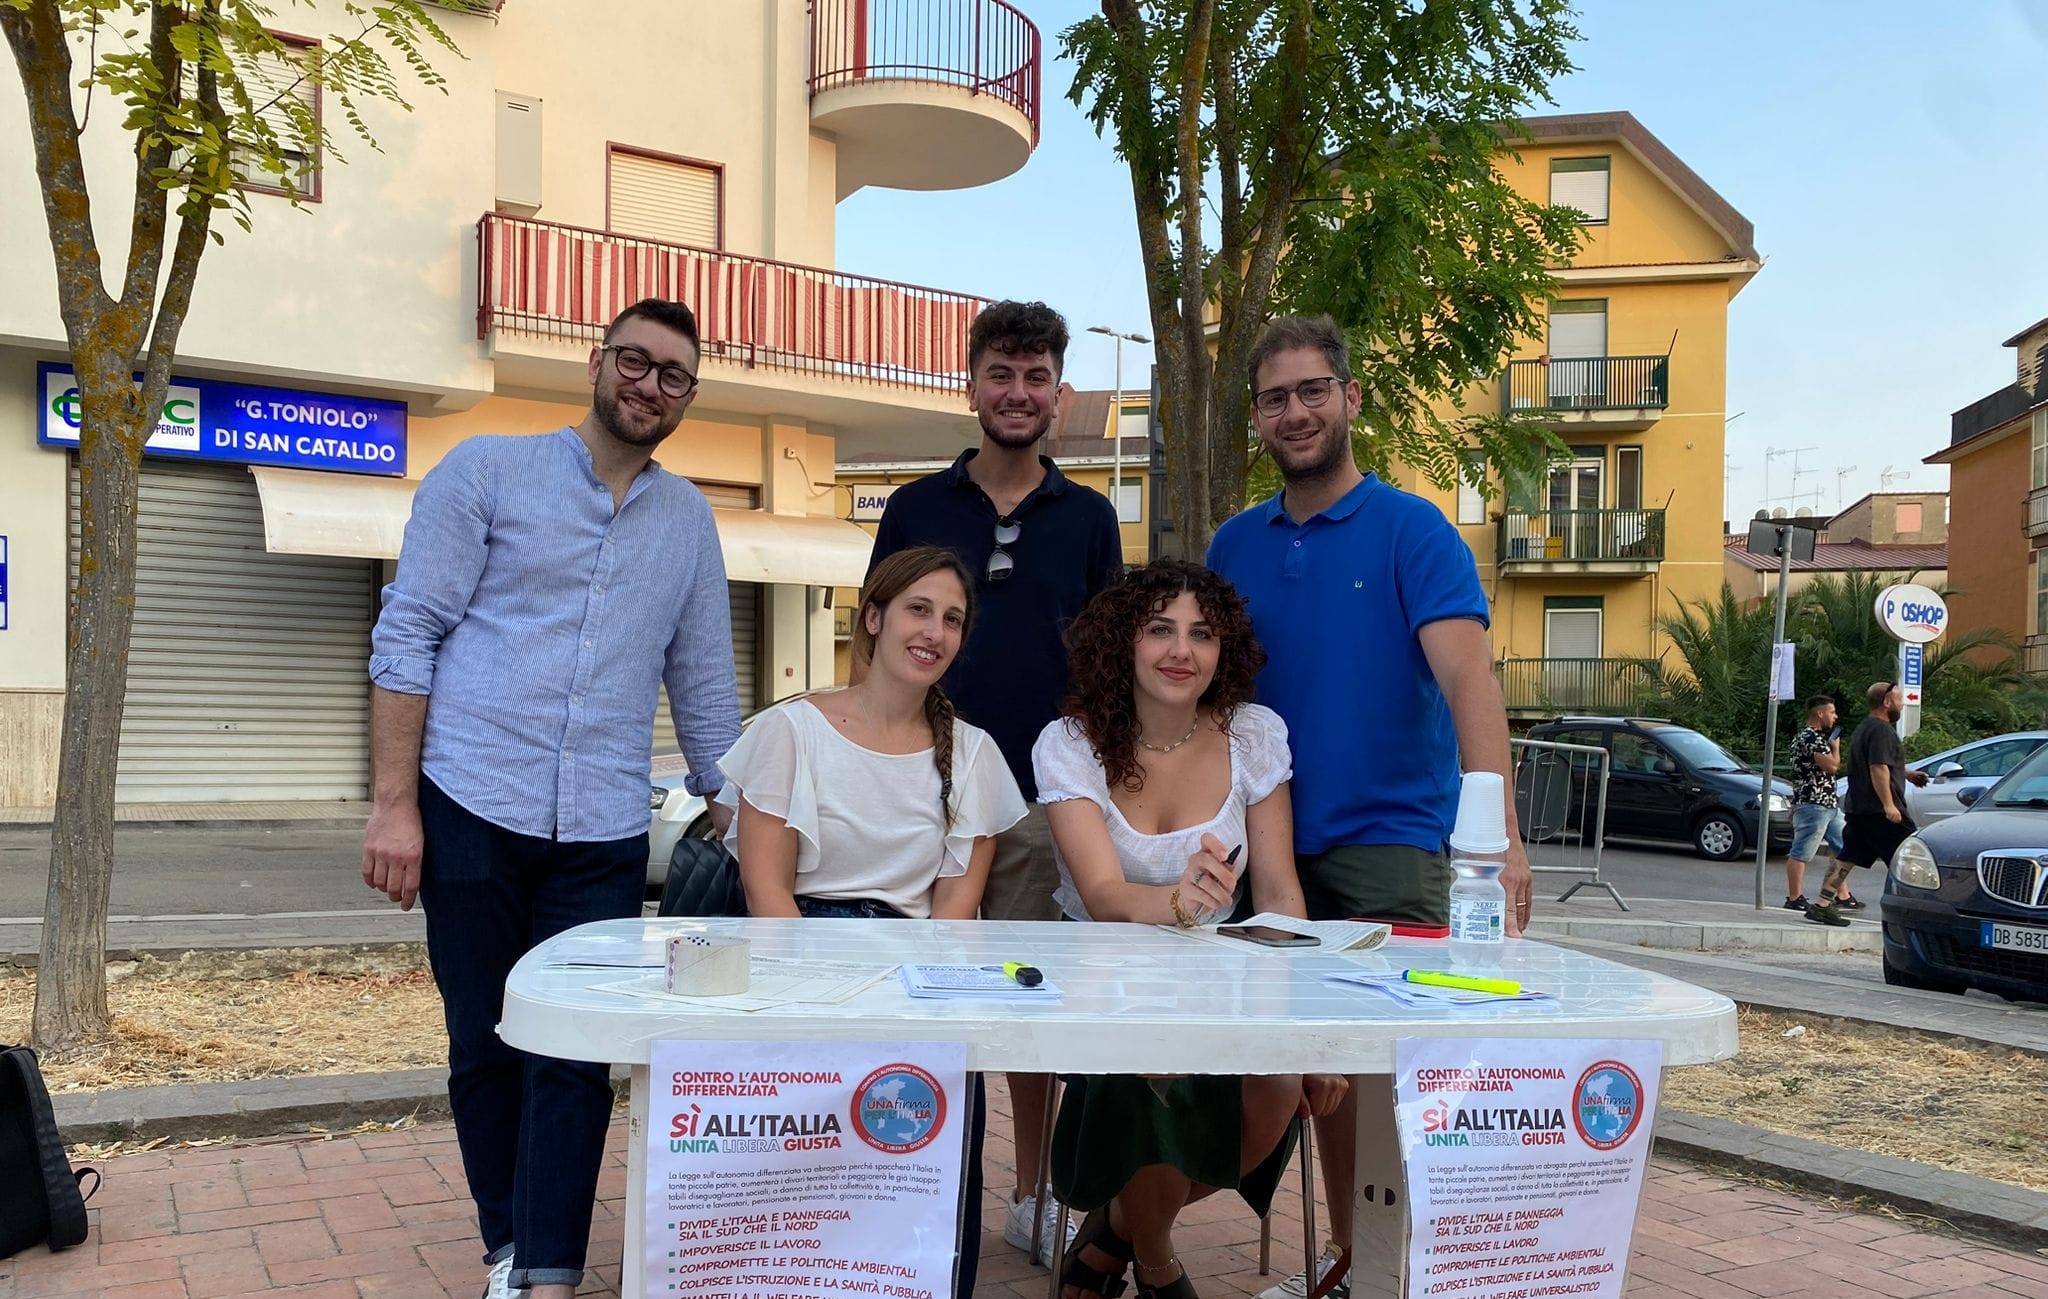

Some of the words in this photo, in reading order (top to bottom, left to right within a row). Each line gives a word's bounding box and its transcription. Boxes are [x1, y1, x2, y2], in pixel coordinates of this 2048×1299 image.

[156, 424, 195, 437] PERATIVO
[215, 428, 238, 448] DI
[244, 432, 290, 452] SAN
[296, 437, 396, 463] CATALDO
[857, 497, 886, 508] BAN
[1994, 928, 2011, 945] DB
[672, 1072, 734, 1084] CONTRO
[1417, 1069, 1474, 1080] CONTRO
[672, 1084, 779, 1097] DIFFERENZIATA
[1418, 1081, 1513, 1092] DIFFERENZIATA
[670, 1103, 702, 1138] SÌ
[1423, 1099, 1448, 1132] SÌ
[670, 1139, 719, 1154] UNITA
[722, 1139, 781, 1154] LIBERA
[784, 1136, 842, 1151] GIUSTA
[1425, 1133, 1469, 1146] UNITA
[1472, 1133, 1519, 1146] LIBERA
[1522, 1132, 1566, 1145] GIUSTA
[680, 1171, 700, 1181] Legge
[757, 1167, 801, 1176] differenziata
[688, 1180, 714, 1191] piccole
[680, 1219, 718, 1231] DIVIDE
[771, 1213, 779, 1222] E
[783, 1210, 851, 1221] DANNEGGIA
[1438, 1215, 1468, 1226] DIVIDE
[1506, 1212, 1512, 1221] E
[1515, 1208, 1564, 1220] DANNEGGIA
[679, 1230, 698, 1241] SIA
[702, 1230, 712, 1239] IL
[715, 1227, 740, 1238] SUD
[743, 1223, 767, 1234] CHE
[771, 1222, 780, 1231] IL
[785, 1221, 818, 1231] NORD
[1435, 1228, 1450, 1237] SIA
[1453, 1227, 1461, 1236] IL
[1463, 1225, 1482, 1235] SUD
[1484, 1223, 1502, 1233] CHE
[1504, 1223, 1511, 1232] IL
[1514, 1220, 1540, 1231] NORD
[679, 1241, 756, 1257] IMPOVERISCE
[760, 1240, 770, 1249] IL
[774, 1239, 821, 1249] LAVORO
[1433, 1241, 1491, 1255] IMPOVERISCE
[1493, 1241, 1500, 1250] IL
[1503, 1238, 1539, 1249] LAVORO
[679, 1257, 769, 1274] COMPROMETTE
[772, 1257, 786, 1267] LE
[790, 1257, 848, 1270] POLITICHE
[851, 1261, 917, 1279] AMBIENTALI
[1432, 1258, 1497, 1275] COMPROMETTE
[1498, 1257, 1510, 1266] LE
[1511, 1253, 1556, 1265] POLITICHE
[1557, 1247, 1606, 1261] AMBIENTALI
[1431, 1279, 1468, 1294] COLPISCE
[1525, 1272, 1532, 1281] E
[1533, 1271, 1544, 1280] LA
[1546, 1264, 1576, 1279] SANITÀ
[1578, 1262, 1614, 1276] PUBBLICA
[679, 1275, 733, 1290] COLPISCE
[814, 1277, 821, 1287] E
[823, 1277, 839, 1289] LA
[841, 1279, 880, 1294] SANITÀ
[883, 1284, 933, 1299] PUBBLICA
[1530, 1281, 1600, 1297] UNIVERSALISTICO
